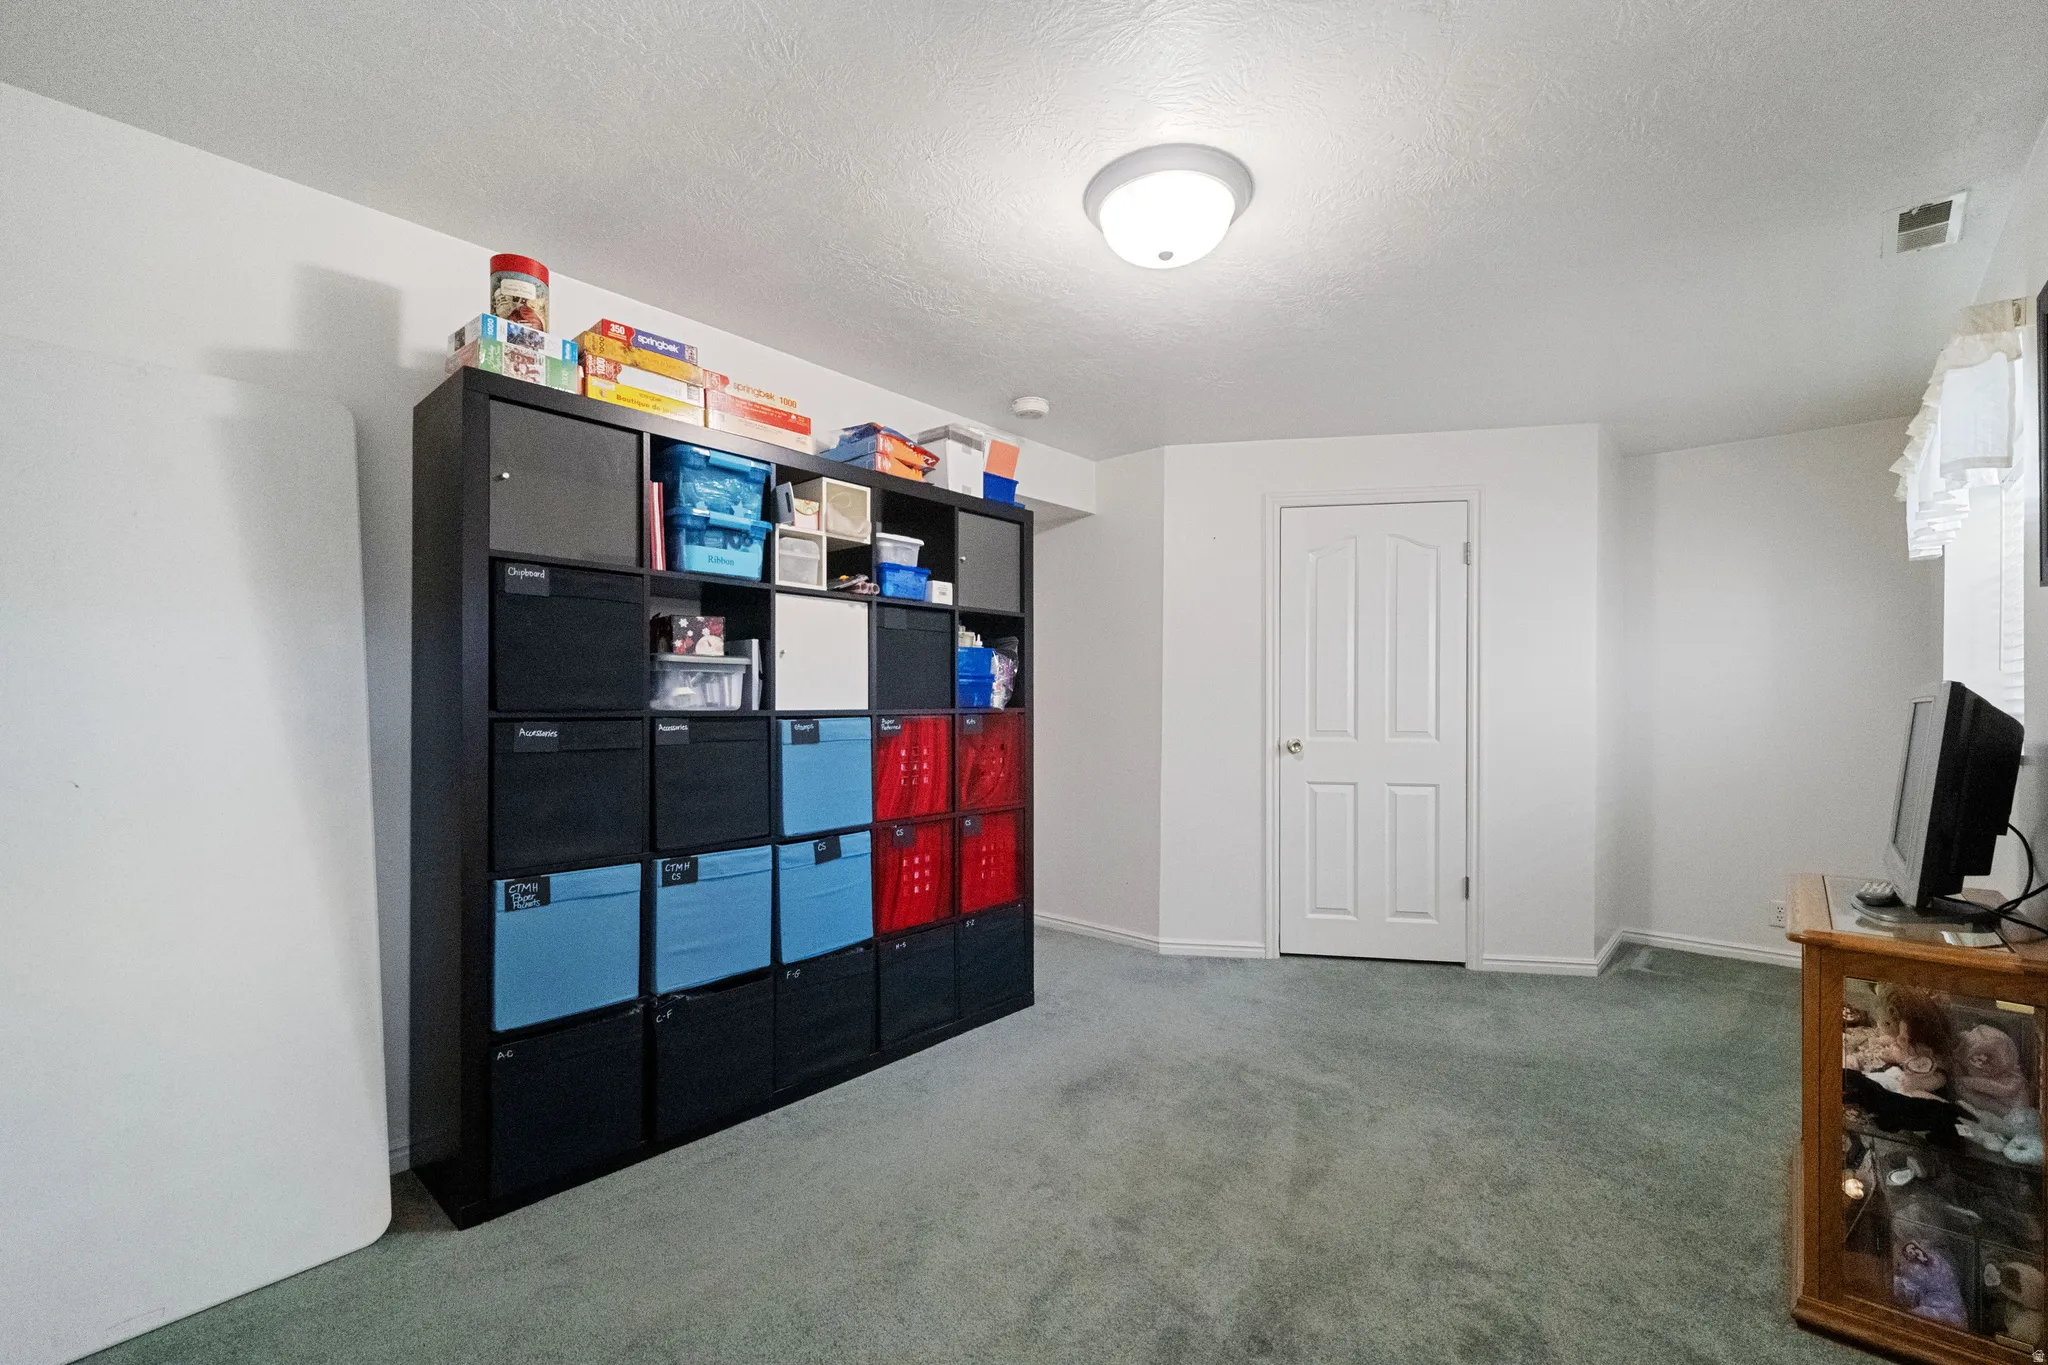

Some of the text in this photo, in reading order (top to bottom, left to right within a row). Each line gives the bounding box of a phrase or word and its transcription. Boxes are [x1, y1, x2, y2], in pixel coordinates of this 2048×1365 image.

[610, 323, 625, 334] 350
[637, 335, 679, 353] springbok
[733, 382, 775, 401] springbok
[779, 397, 797, 408] 1000
[616, 394, 650, 408] Boutique
[707, 555, 735, 566] Ribbon
[507, 566, 545, 579] Chipboard
[896, 828, 904, 836] CS
[817, 841, 827, 851] CS
[664, 862, 690, 872] CTMH
[671, 872, 681, 881] CS
[509, 882, 538, 893] CTMH
[511, 893, 536, 903] Paper
[656, 1009, 673, 1023] C-F
